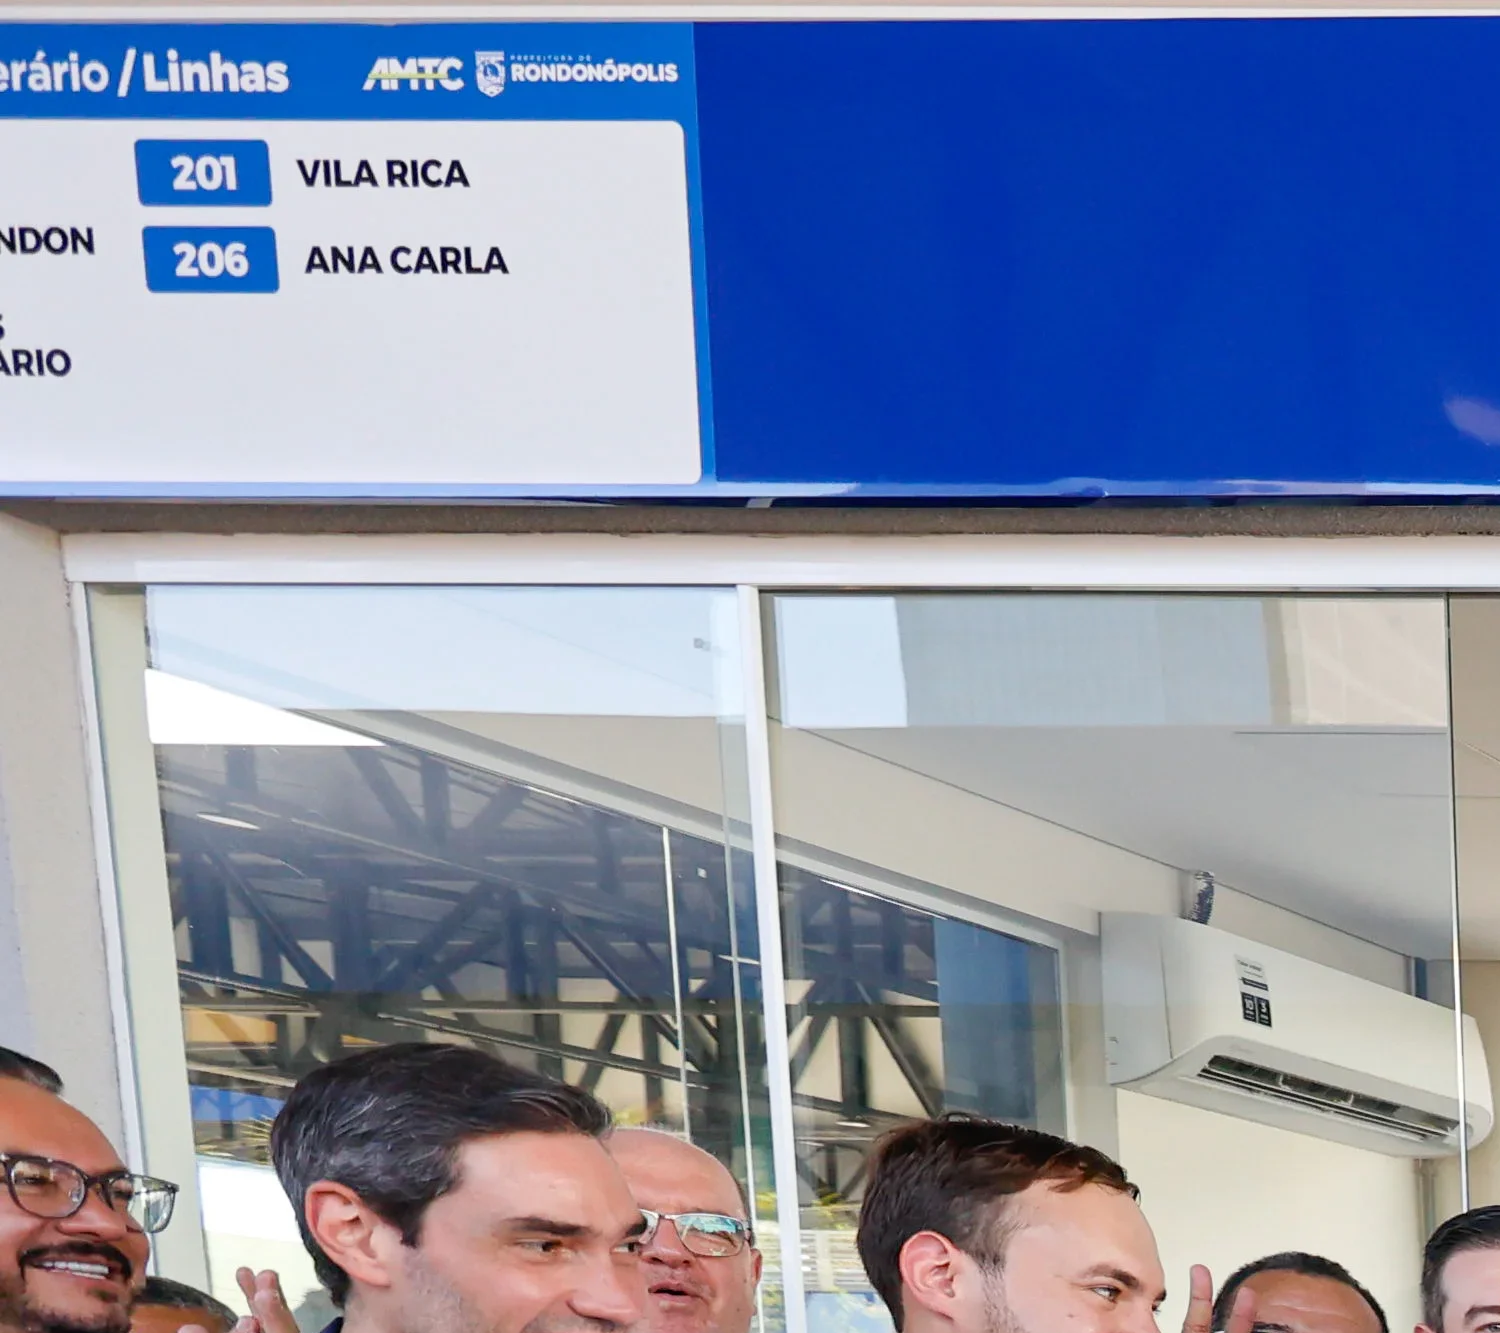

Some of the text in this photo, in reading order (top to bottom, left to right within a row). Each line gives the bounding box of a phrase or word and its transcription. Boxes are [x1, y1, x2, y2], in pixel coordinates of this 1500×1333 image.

[117, 46, 137, 97] /
[143, 50, 289, 92] Linhas
[362, 57, 465, 91] AMTC
[511, 59, 678, 83] RONDONÓPOLIS
[171, 156, 237, 190] 201
[297, 159, 470, 188] VILA RICA
[172, 243, 249, 277] 206
[305, 246, 509, 274] ANA CARLA
